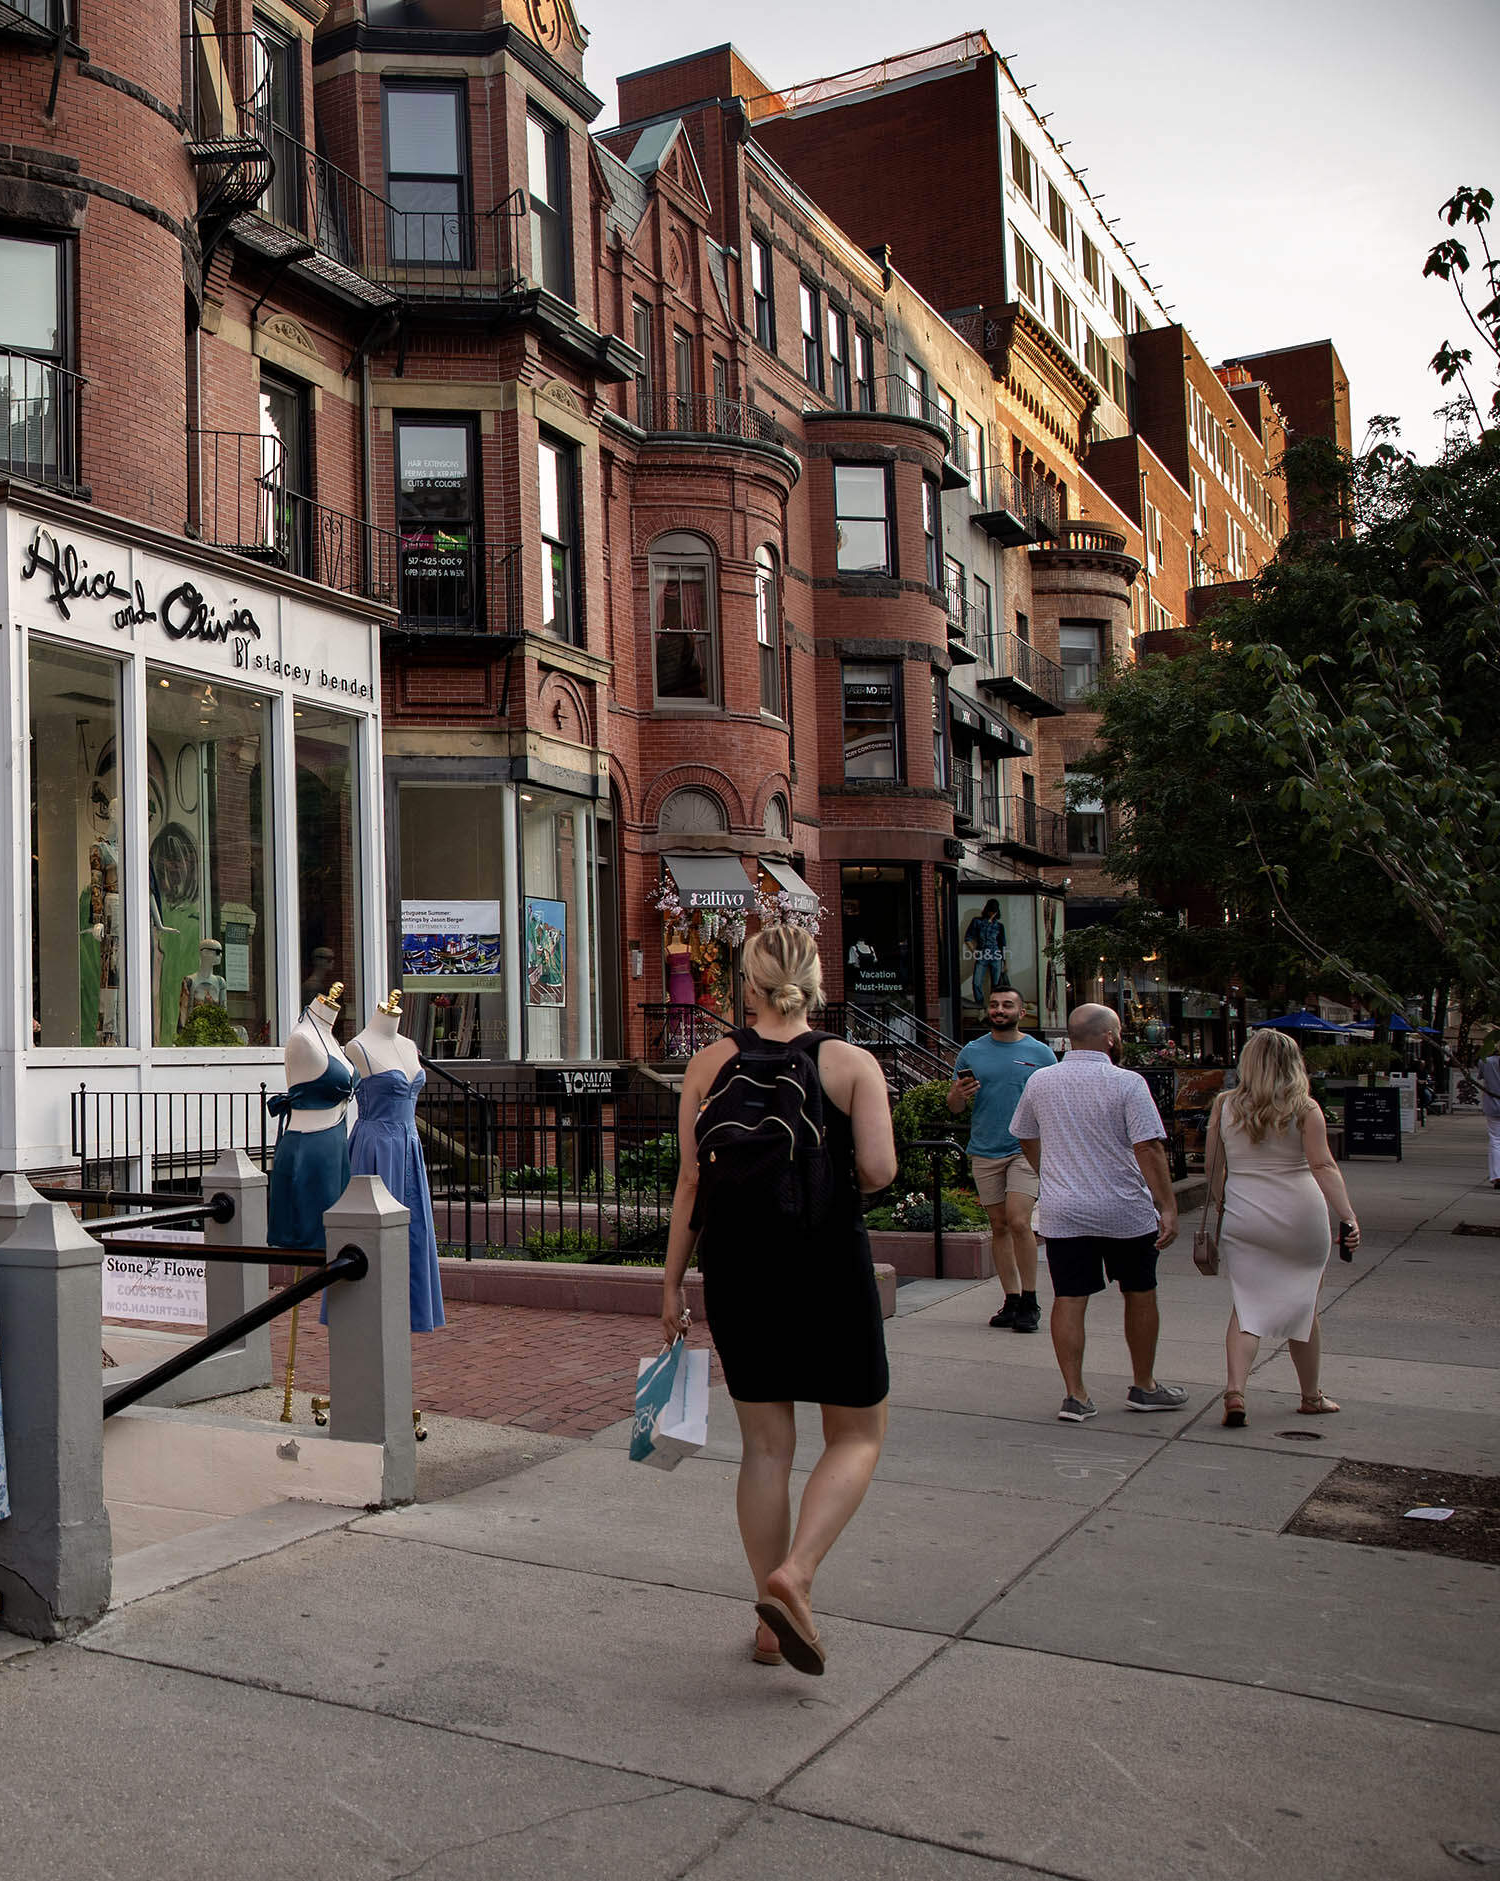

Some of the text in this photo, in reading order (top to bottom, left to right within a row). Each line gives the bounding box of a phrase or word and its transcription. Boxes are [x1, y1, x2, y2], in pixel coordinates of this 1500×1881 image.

[434, 480, 461, 488] COLORS
[22, 522, 261, 643] Alice and Olivia
[235, 636, 375, 700] BY stacey bendet
[690, 891, 744, 906] cattivo
[962, 949, 1013, 961] ba&sh
[859, 970, 896, 978] Vacation
[855, 983, 903, 991] Must-Haves
[583, 1072, 612, 1088] SALON
[107, 1258, 144, 1274] Stone
